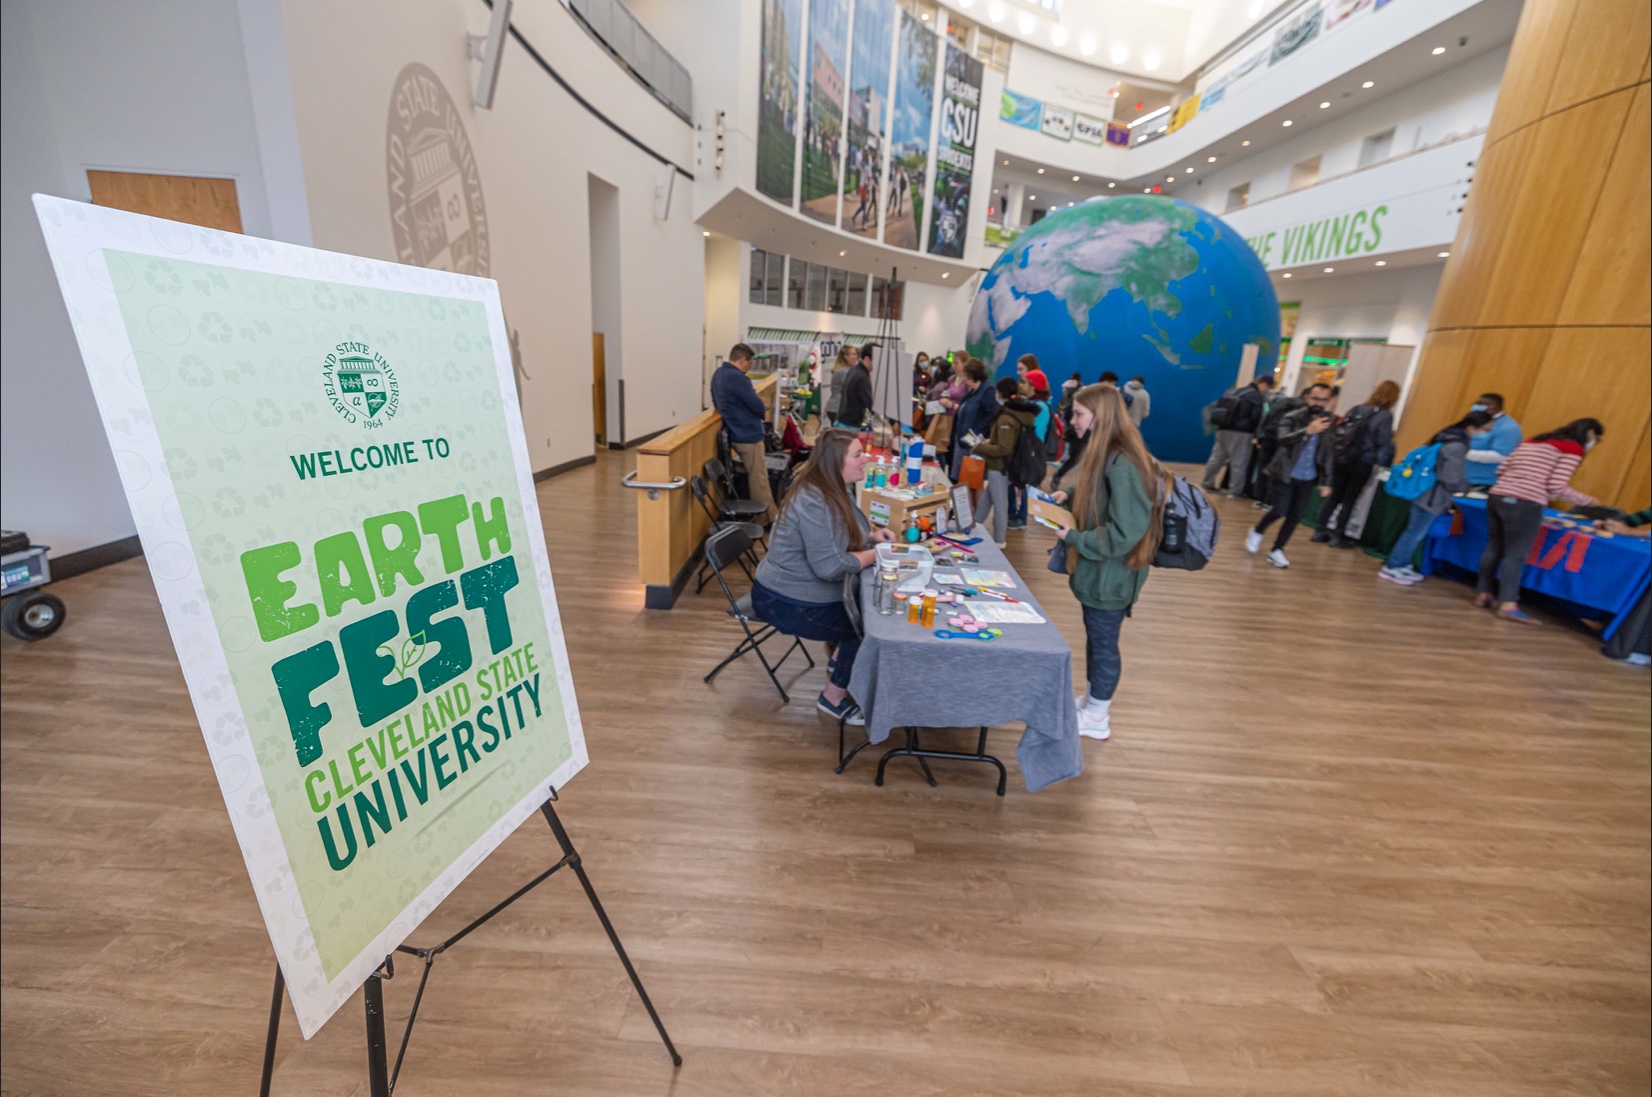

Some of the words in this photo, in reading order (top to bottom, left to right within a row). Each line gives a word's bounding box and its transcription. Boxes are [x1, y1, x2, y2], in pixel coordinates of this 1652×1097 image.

[396, 75, 440, 132] STATE
[941, 97, 977, 148] CSU
[1282, 205, 1389, 265] VIKINGS
[335, 341, 370, 355] STATE
[322, 353, 357, 424] CLEVELAND
[374, 352, 399, 421] UNIVERSITY
[363, 419, 383, 430] 1964
[290, 441, 419, 480] WELCOME
[422, 437, 450, 460] TO
[240, 493, 512, 642] EARTH
[271, 555, 519, 768] FEST
[304, 681, 472, 814] CLEVELAND
[476, 642, 539, 701] STATE
[317, 672, 542, 872] UNIVERSITY
